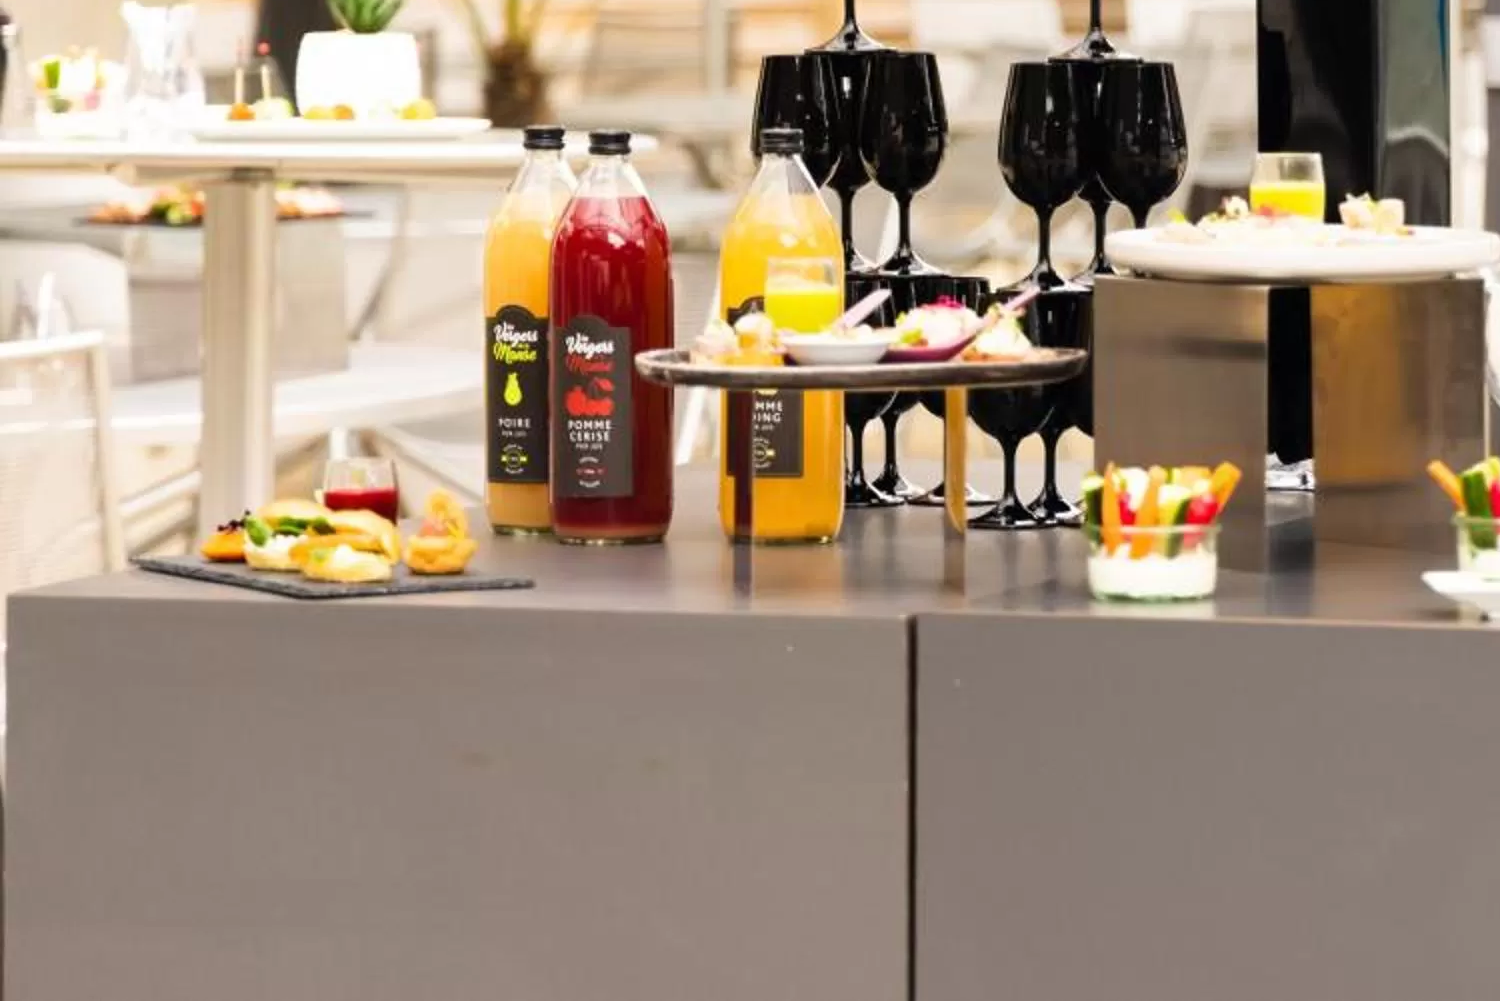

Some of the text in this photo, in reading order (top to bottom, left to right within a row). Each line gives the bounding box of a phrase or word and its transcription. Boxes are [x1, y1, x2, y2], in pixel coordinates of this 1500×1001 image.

[754, 401, 783, 412] MME
[498, 418, 531, 428] POIRE
[753, 412, 781, 423] ING
[567, 419, 612, 430] POMME
[569, 430, 610, 442] CERISE
